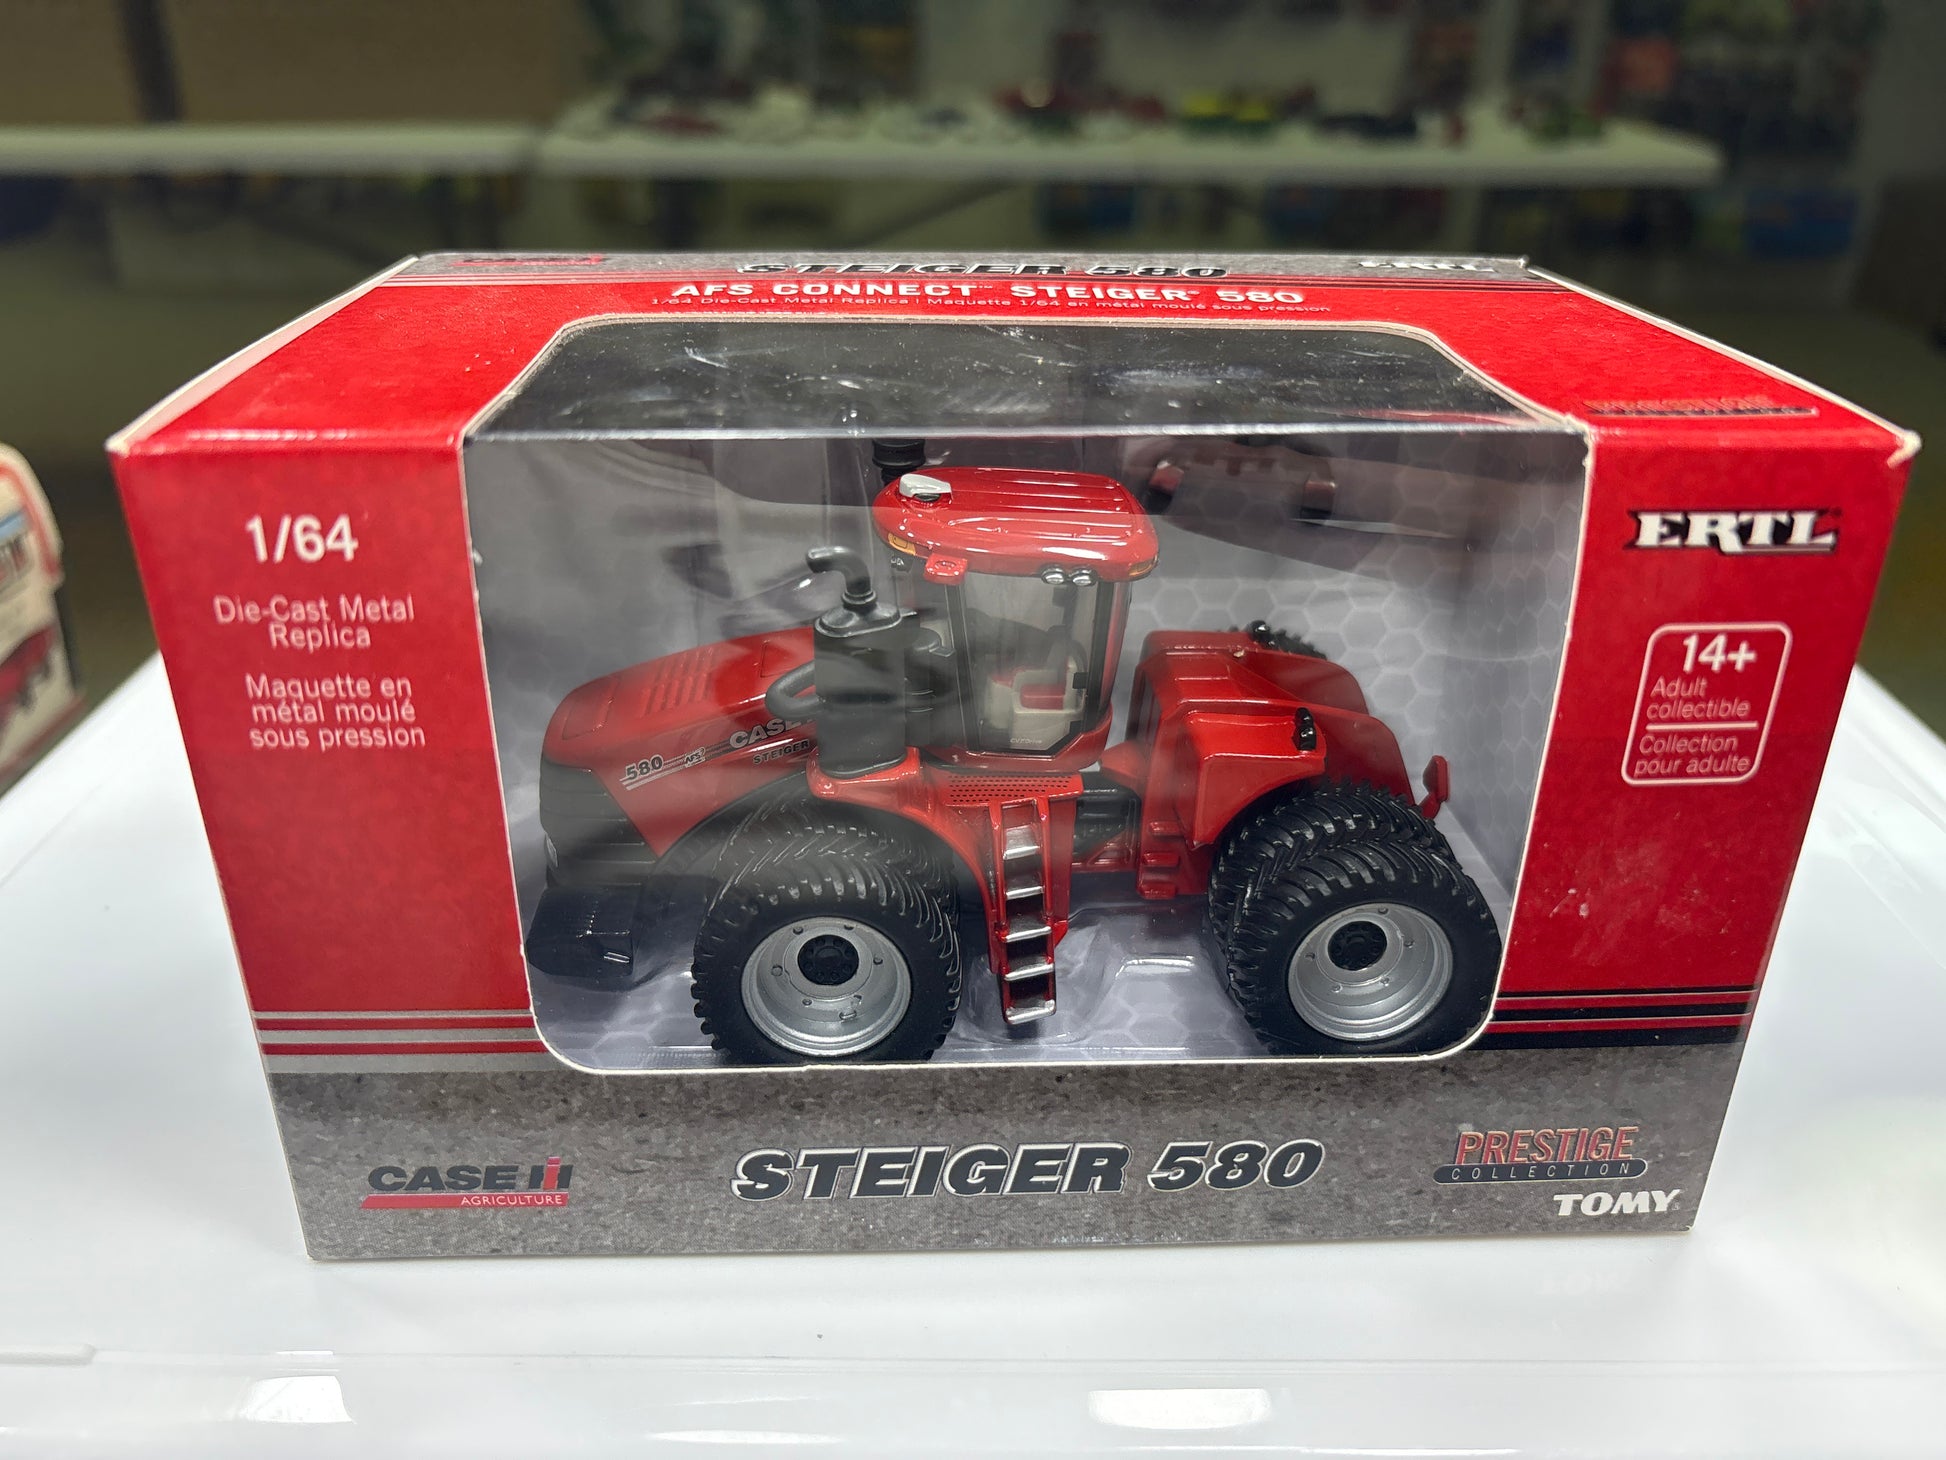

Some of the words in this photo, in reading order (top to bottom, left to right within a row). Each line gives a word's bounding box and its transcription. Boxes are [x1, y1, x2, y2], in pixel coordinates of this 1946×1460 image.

[737, 263, 1069, 275] STEIGER
[1085, 265, 1228, 278] 580
[671, 284, 754, 297] AFS
[1215, 290, 1305, 303] 580
[701, 297, 776, 305] Die-Cast
[784, 297, 834, 305] Metal
[841, 297, 909, 306] Replica
[927, 298, 1012, 307] Maquette
[1020, 299, 1061, 307] 1/64
[1096, 301, 1145, 309] métal
[1212, 304, 1253, 312] sous
[1258, 305, 1331, 313] pression
[246, 514, 359, 563] 1/64
[1630, 508, 1839, 554] ERTL
[213, 595, 330, 624] Die-Cast
[339, 594, 415, 623] Metal
[269, 621, 371, 653] Replica
[1682, 633, 1757, 673] 14+
[245, 673, 371, 702] Maquette
[380, 677, 412, 698] en
[1651, 676, 1707, 698] Adult
[252, 699, 325, 723] métal
[336, 699, 416, 723] moulé
[1647, 697, 1750, 719] collectible
[250, 727, 310, 748] sous
[318, 724, 426, 752] pression
[1639, 733, 1738, 754] Collection
[753, 739, 810, 765] STEIGER
[1633, 757, 1682, 777] pour
[1686, 754, 1750, 774] adulte
[625, 754, 664, 781] 580
[1454, 1126, 1640, 1165] PRESTIGE
[367, 1164, 519, 1192] CASE
[729, 1142, 1135, 1203] STEIGER
[1146, 1138, 1326, 1193] 580
[1451, 1162, 1631, 1181] COLLECTION
[460, 1194, 563, 1206] AGRICULTURE
[1553, 1188, 1681, 1217] TOMY
